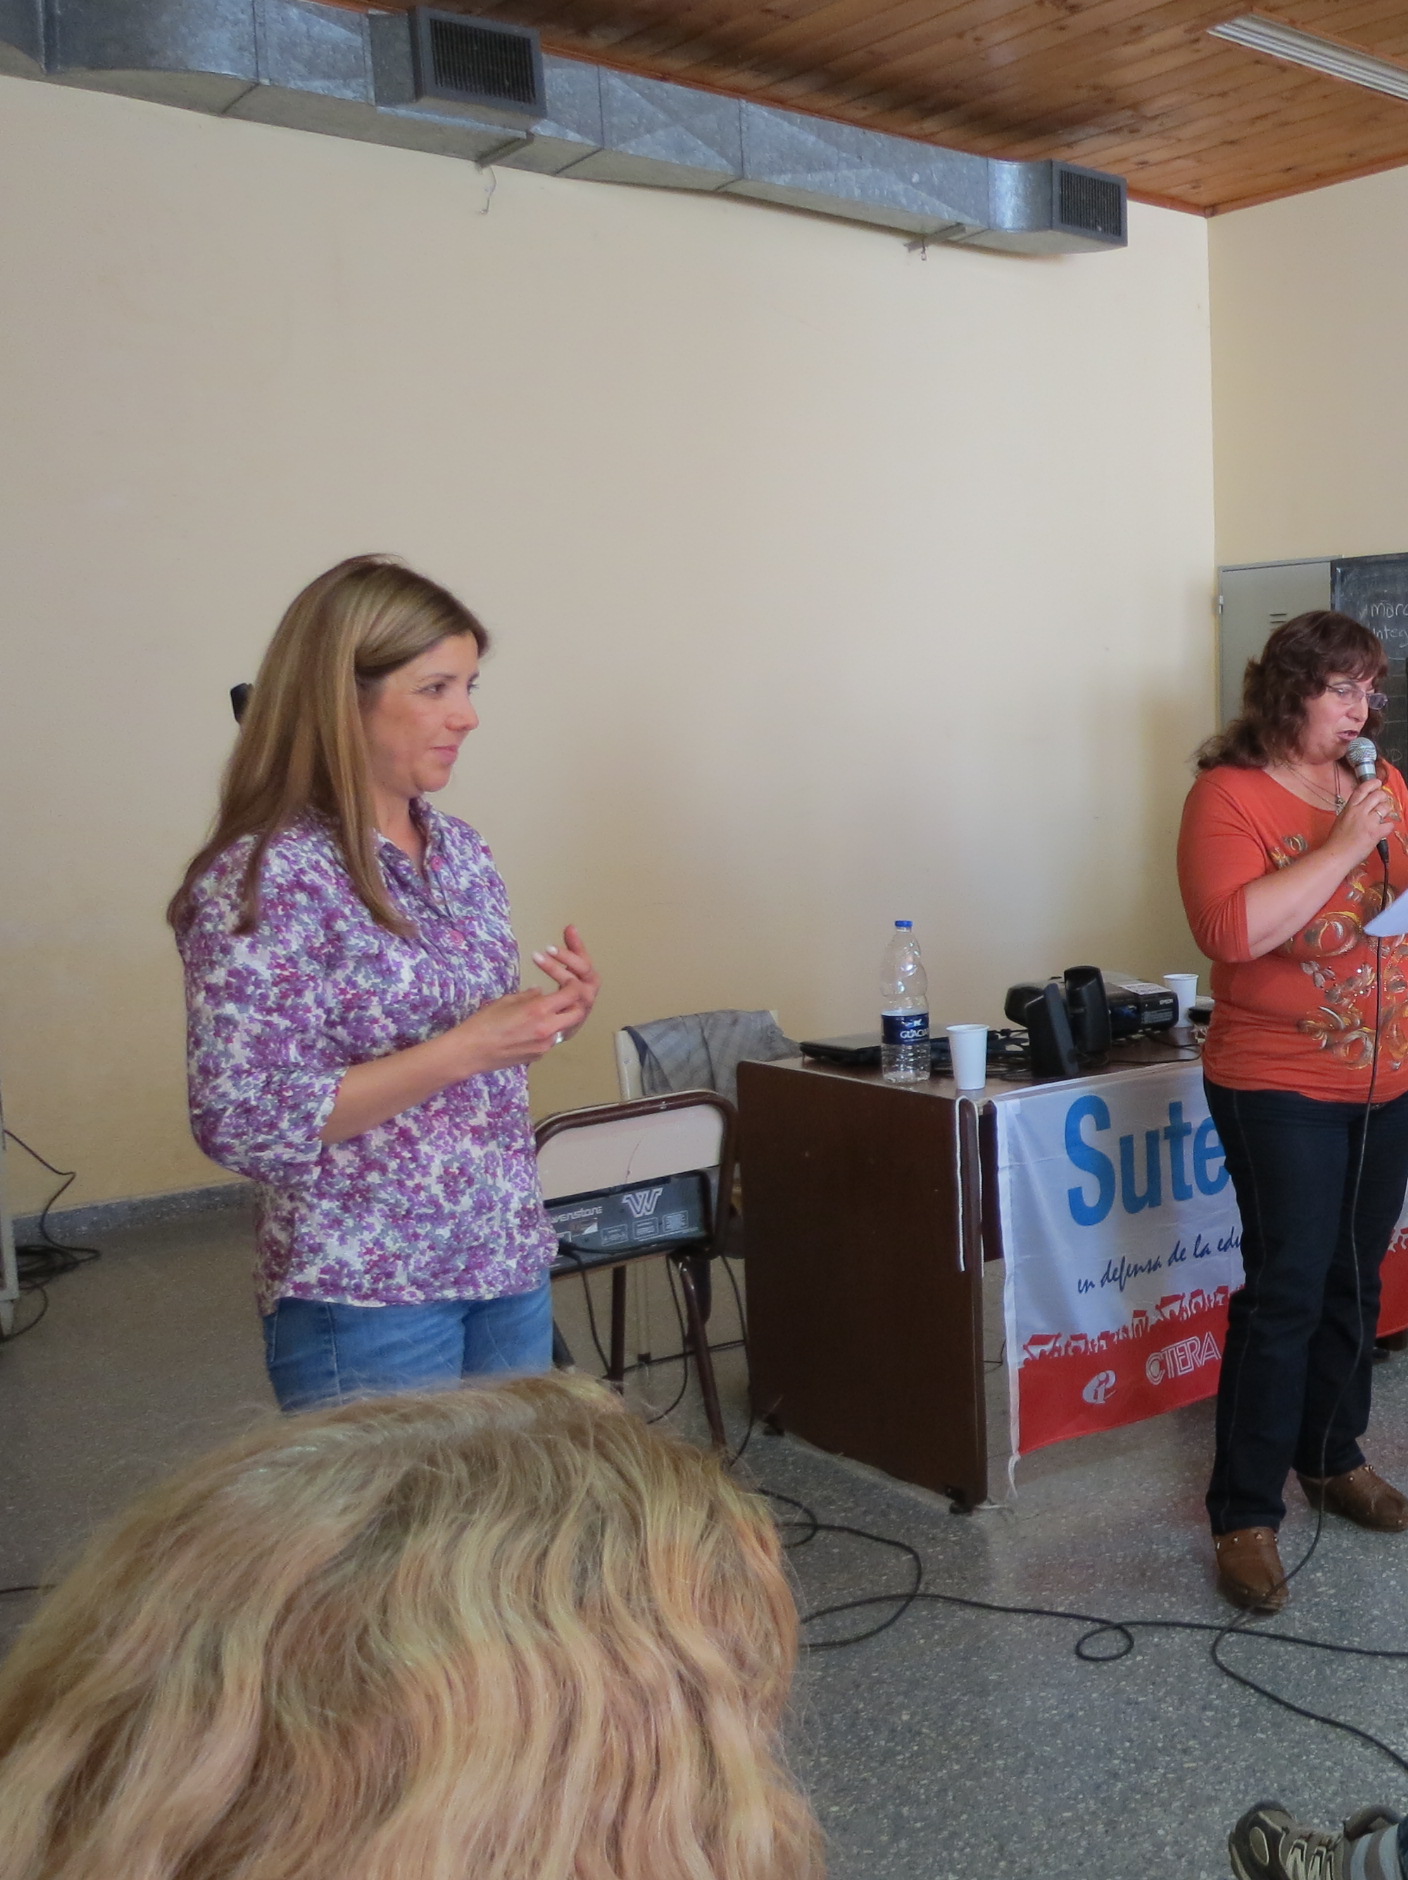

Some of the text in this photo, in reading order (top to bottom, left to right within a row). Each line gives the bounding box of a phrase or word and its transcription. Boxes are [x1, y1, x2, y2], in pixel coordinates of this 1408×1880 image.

[1064, 1093, 1231, 1227] Sute
[1077, 1277, 1095, 1294] en
[1100, 1255, 1162, 1292] defensa
[1167, 1239, 1187, 1265] de
[1192, 1233, 1212, 1259] la
[1145, 1330, 1222, 1386] CTERA
